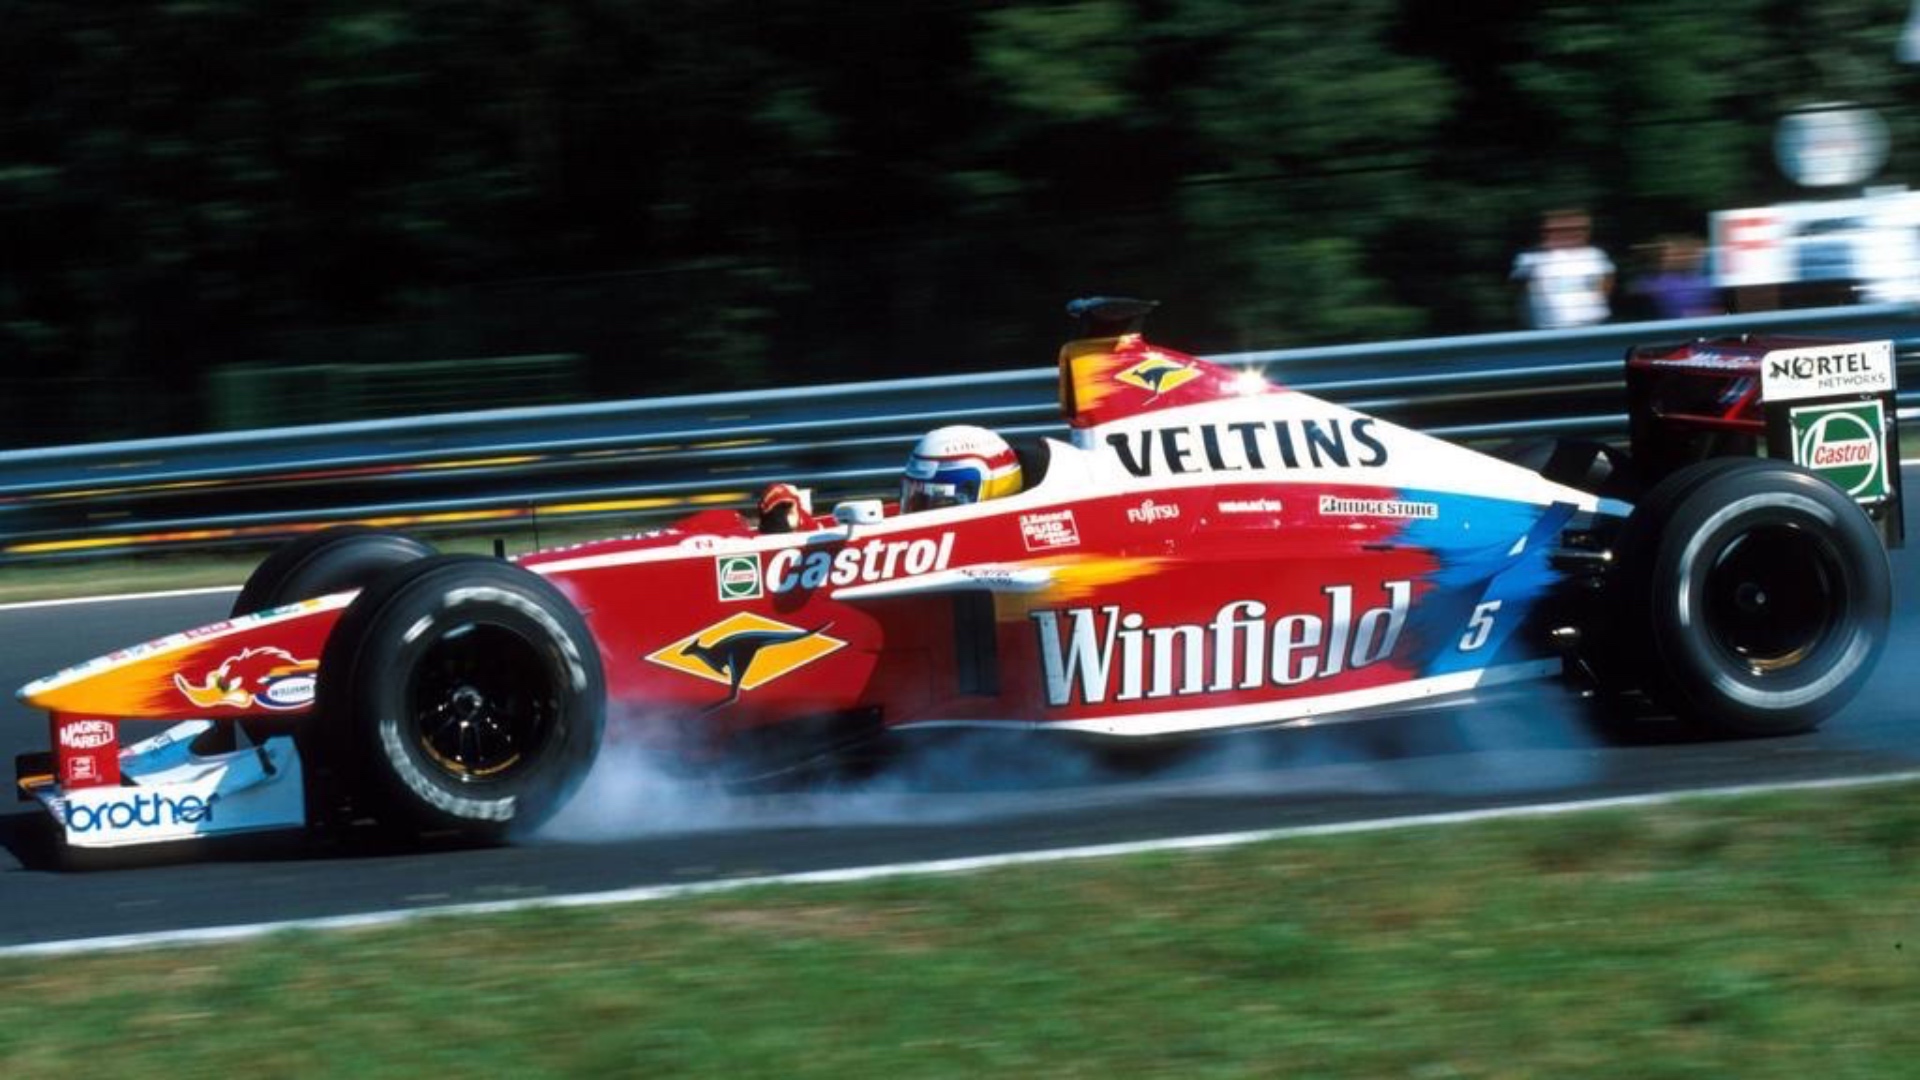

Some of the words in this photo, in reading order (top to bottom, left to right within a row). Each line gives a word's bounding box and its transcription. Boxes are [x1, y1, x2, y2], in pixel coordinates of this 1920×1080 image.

[1769, 352, 1871, 378] NORTEL
[1818, 372, 1886, 389] NETWORKS
[1106, 417, 1388, 477] VELTINS
[1815, 442, 1873, 466] Castrol
[1127, 499, 1180, 524] FUJITSU
[1321, 498, 1435, 517] BRIDGESTONE
[766, 532, 956, 593] Castrol
[1459, 600, 1501, 652] 5
[1030, 580, 1411, 706] Winfield
[65, 792, 221, 832] brother
